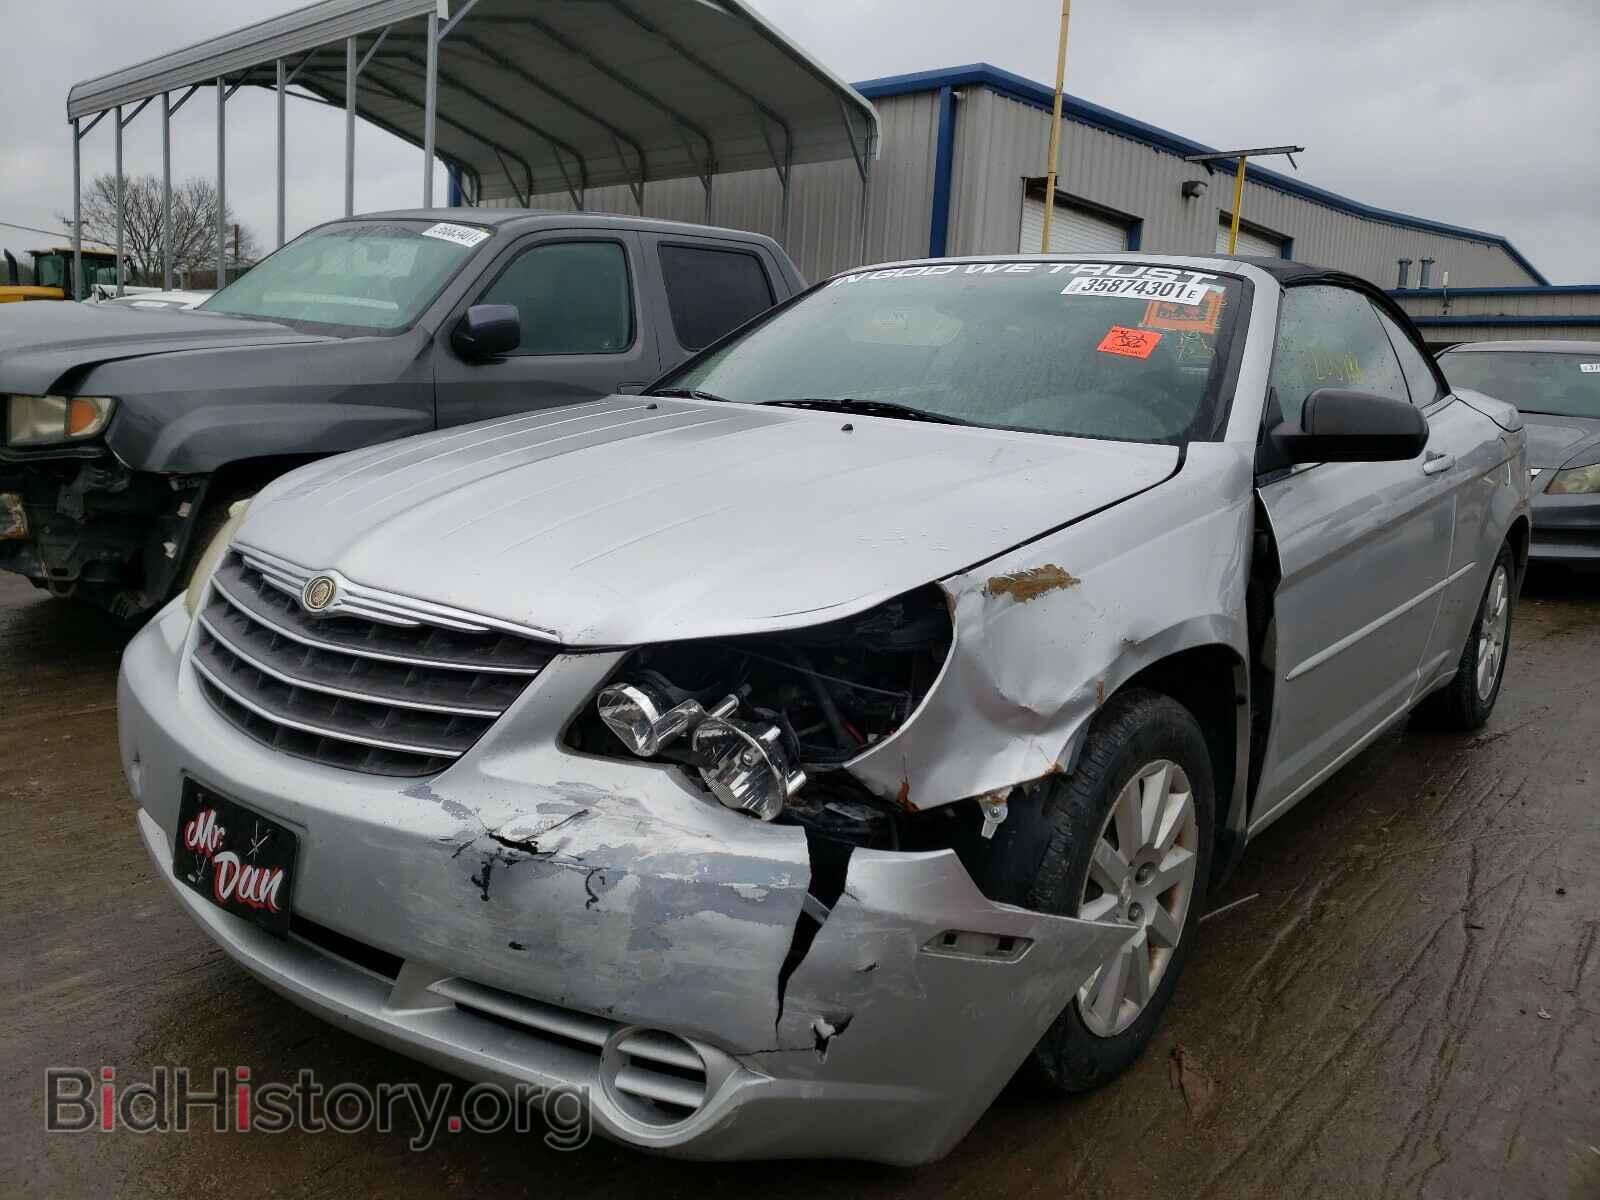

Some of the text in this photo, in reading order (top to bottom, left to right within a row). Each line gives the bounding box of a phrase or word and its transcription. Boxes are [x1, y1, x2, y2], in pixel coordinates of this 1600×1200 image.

[827, 263, 1219, 288] IN GOD WE TRUST
[1081, 278, 1187, 299] 35874301
[184, 809, 225, 857] Mr.
[214, 851, 283, 912] Dan
